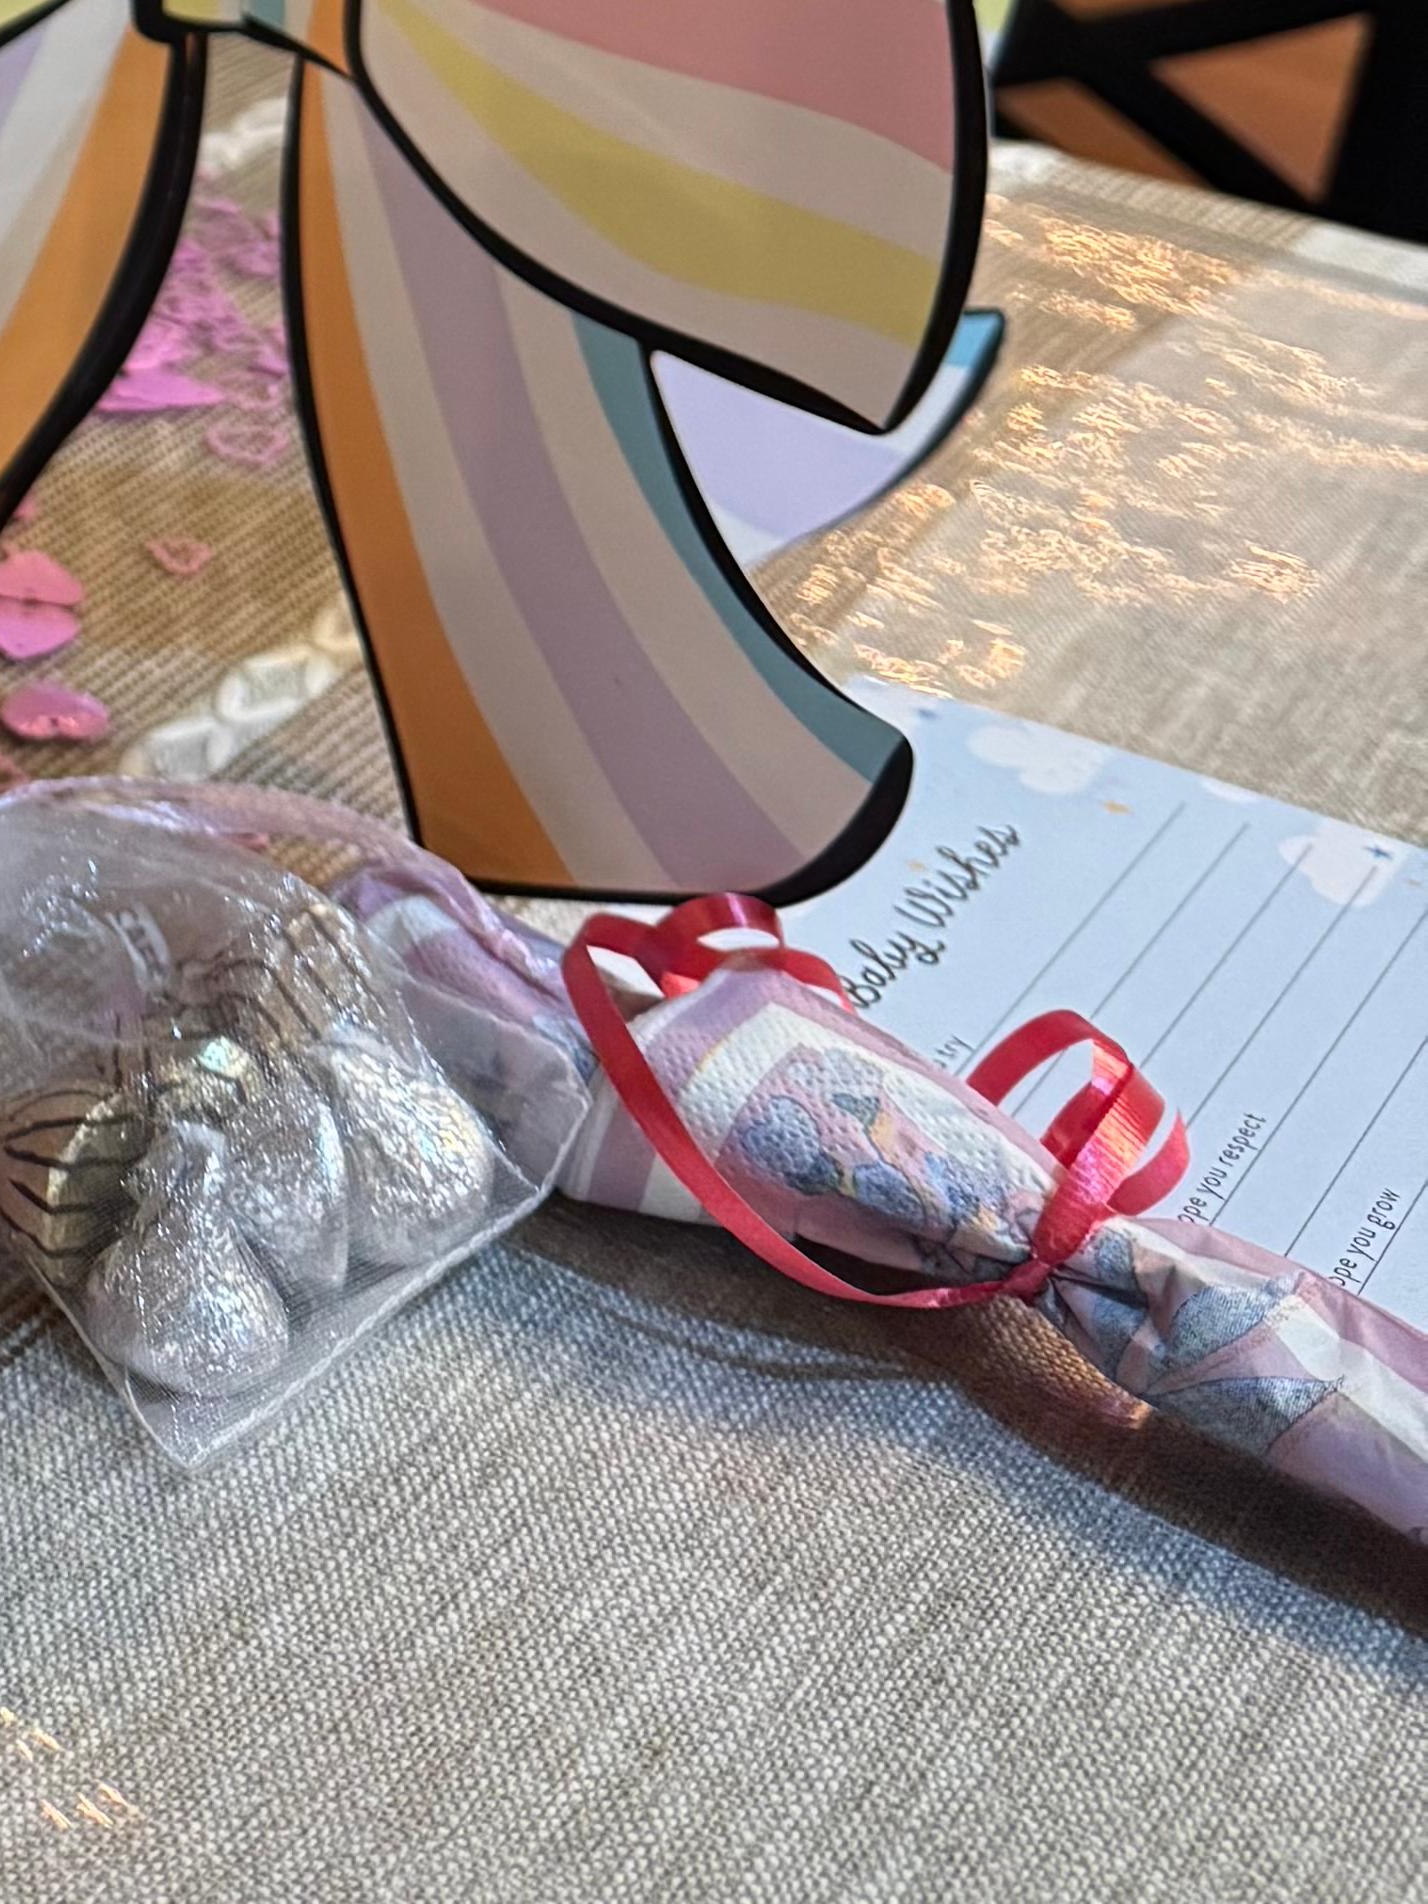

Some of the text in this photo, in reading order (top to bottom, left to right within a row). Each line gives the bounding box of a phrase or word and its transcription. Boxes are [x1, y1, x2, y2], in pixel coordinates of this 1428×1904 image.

[893, 824, 1022, 928] Wishes
[1177, 1112, 1267, 1226] ope you respect
[1328, 1187, 1401, 1288] ope you grow
